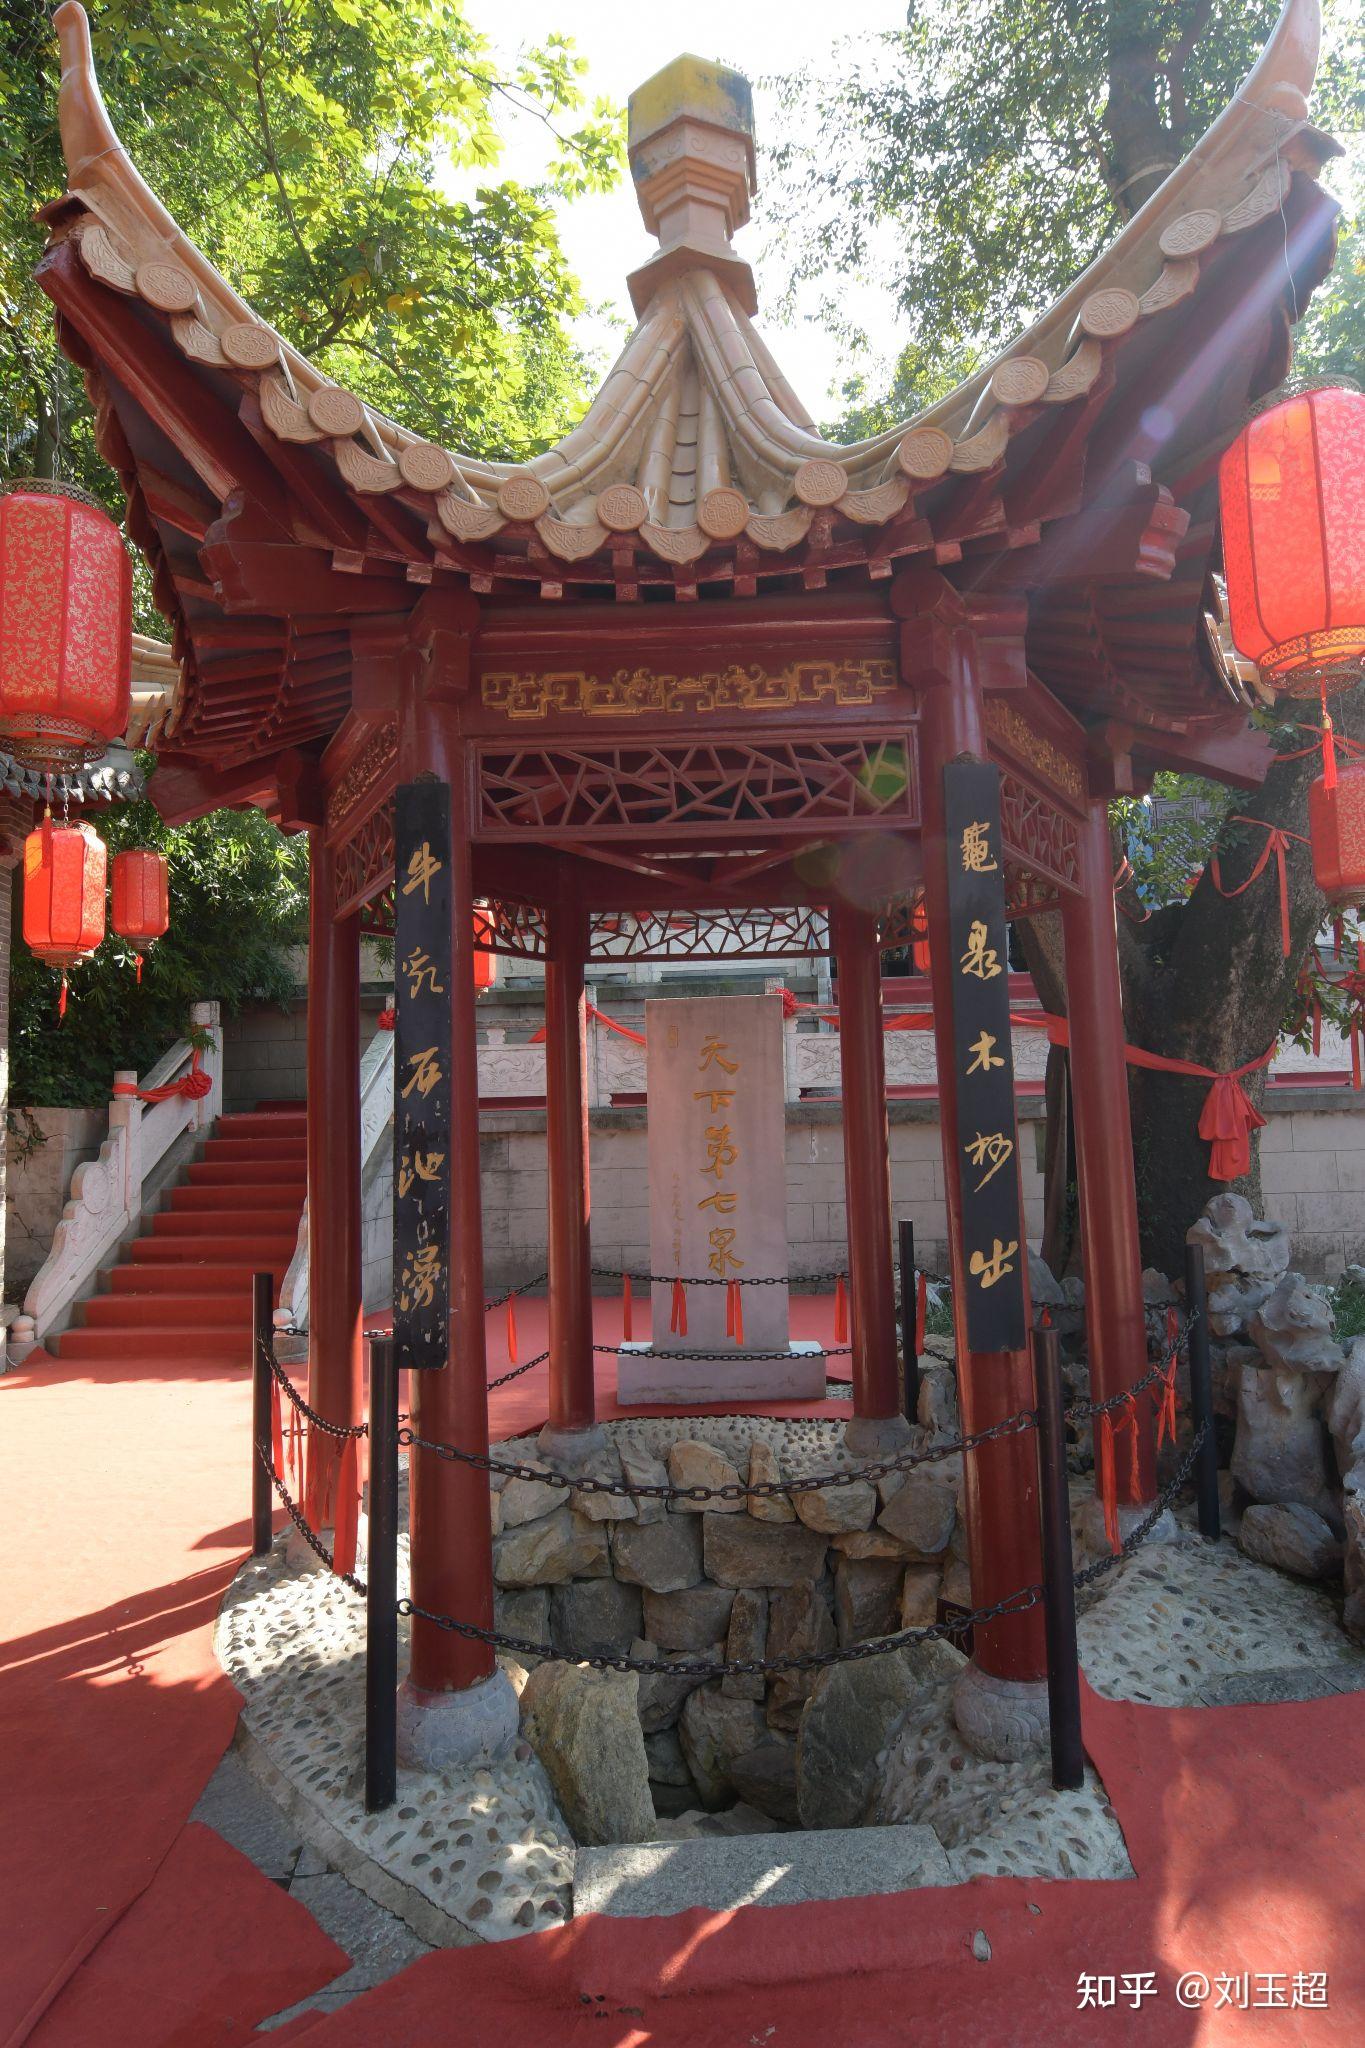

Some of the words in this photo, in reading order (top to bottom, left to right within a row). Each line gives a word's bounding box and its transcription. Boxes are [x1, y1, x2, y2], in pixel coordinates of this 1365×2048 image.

[692, 1033, 745, 1278] 天下第七泉
